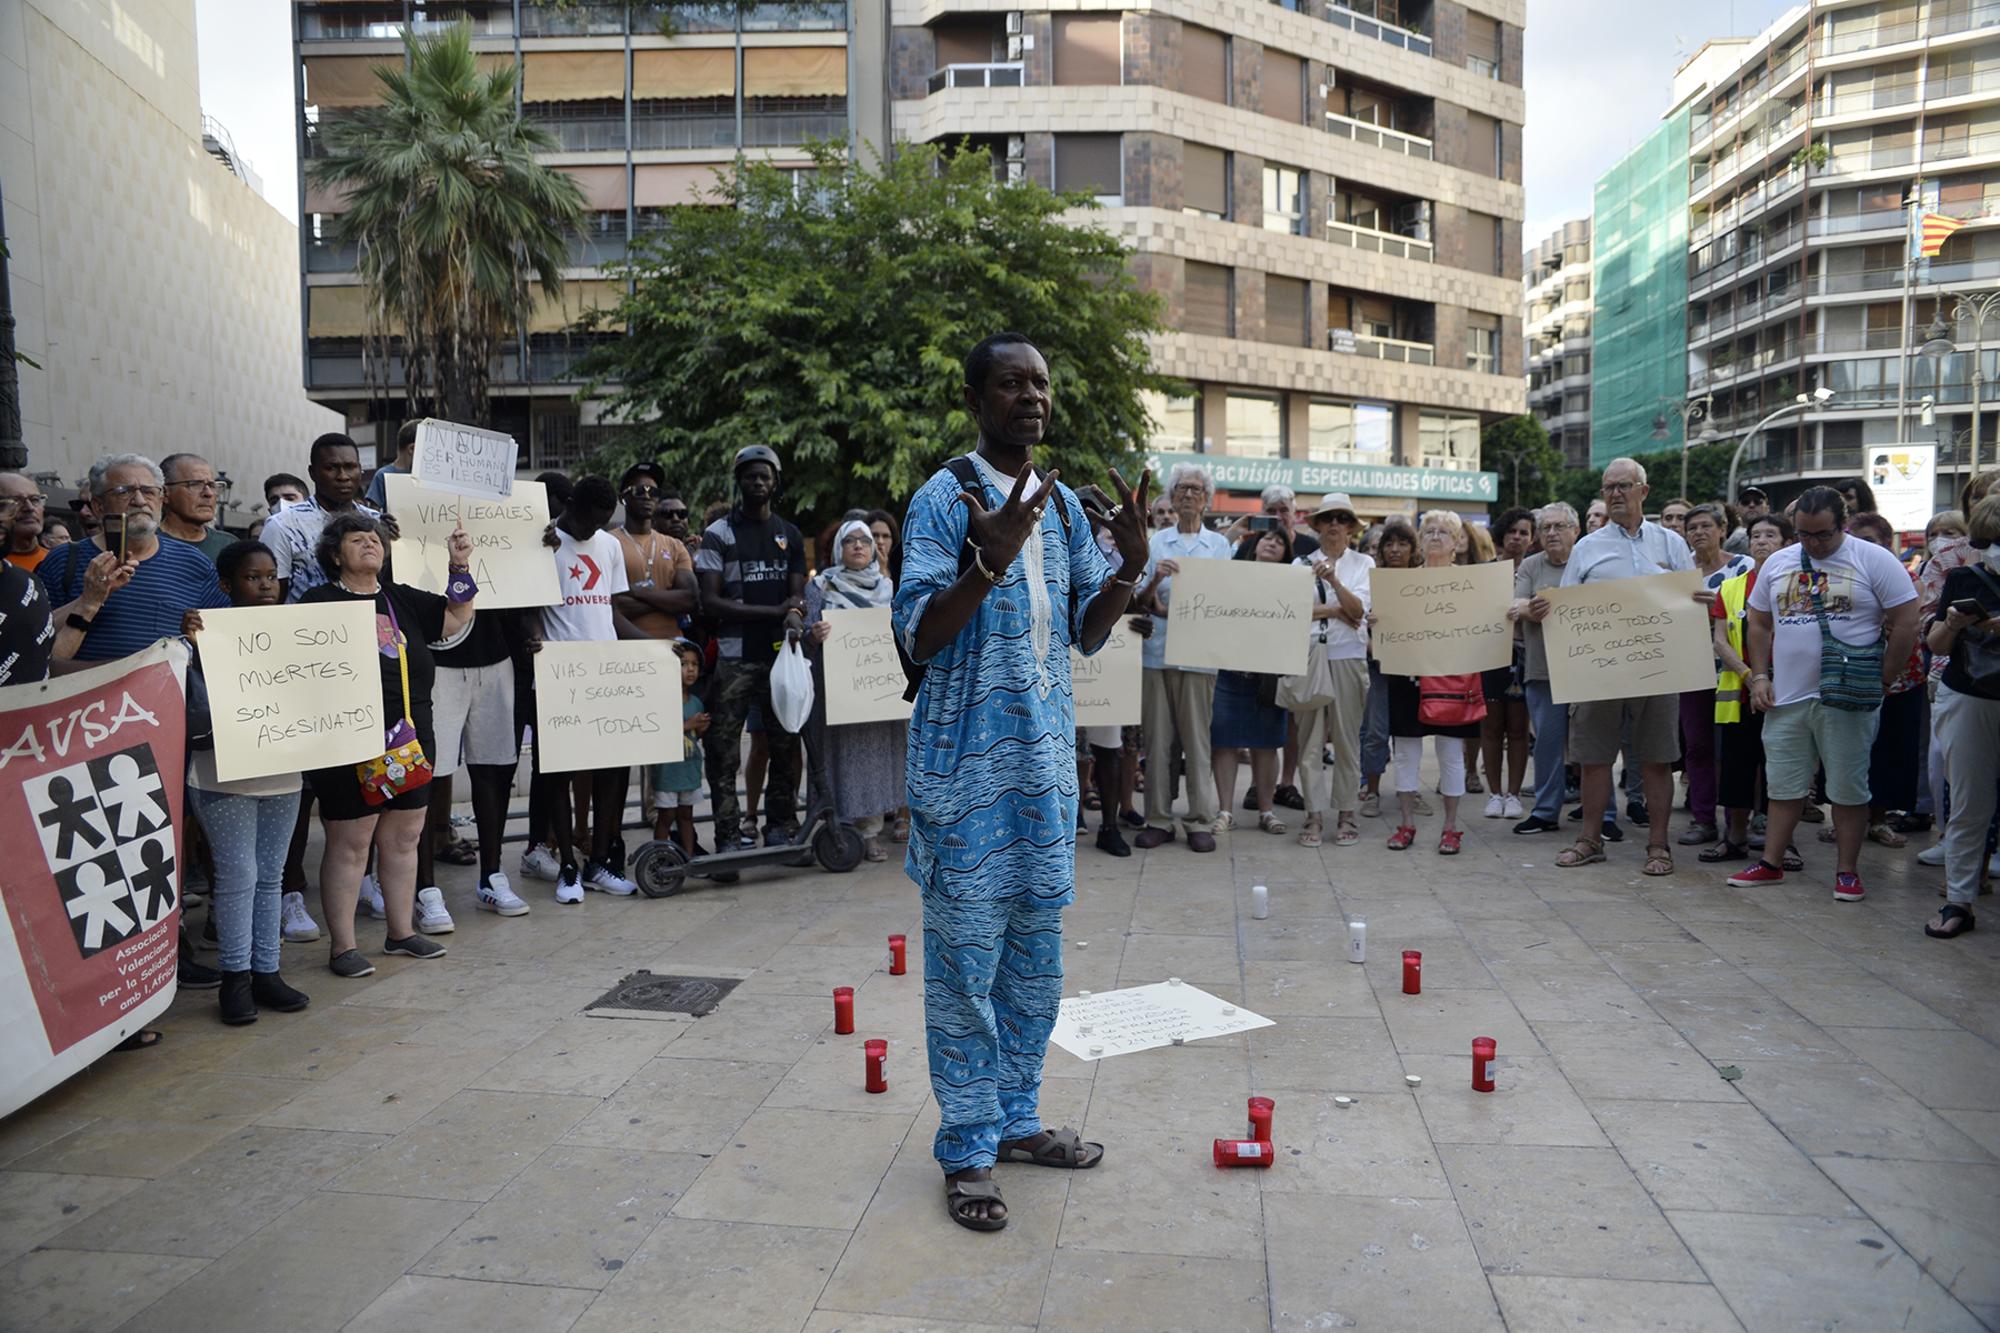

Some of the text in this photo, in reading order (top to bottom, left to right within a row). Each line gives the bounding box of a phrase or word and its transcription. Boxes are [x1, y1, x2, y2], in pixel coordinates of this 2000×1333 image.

[1301, 467, 1419, 491] ESPECIALIDADES
[1421, 470, 1474, 494] ÓPTICAS
[467, 505, 534, 521] LEGALES
[416, 535, 427, 555] Y
[1400, 579, 1474, 597] CONTRA
[1424, 602, 1457, 615] LAS
[1554, 602, 1622, 625] REFUGIO
[1379, 622, 1505, 645] NECROPOLITICAS
[1571, 611, 1673, 636] PARA TODOS
[238, 624, 348, 656] NO SON
[1568, 632, 1665, 658] LOS COLORES
[855, 652, 883, 668] LAS
[1591, 648, 1664, 668] DE OJOS
[239, 661, 358, 693] MUERTES,
[550, 661, 657, 680] VIAS LEGALES
[569, 685, 645, 704] Y SEGURAS
[236, 702, 280, 722] SON
[0, 691, 160, 769] AVSA
[547, 711, 660, 737] PARA TODAS
[115, 922, 168, 962] Associació
[118, 939, 169, 976] Valenciana
[99, 986, 122, 1007] per
[126, 979, 137, 990] la
[120, 991, 141, 1010] amb
